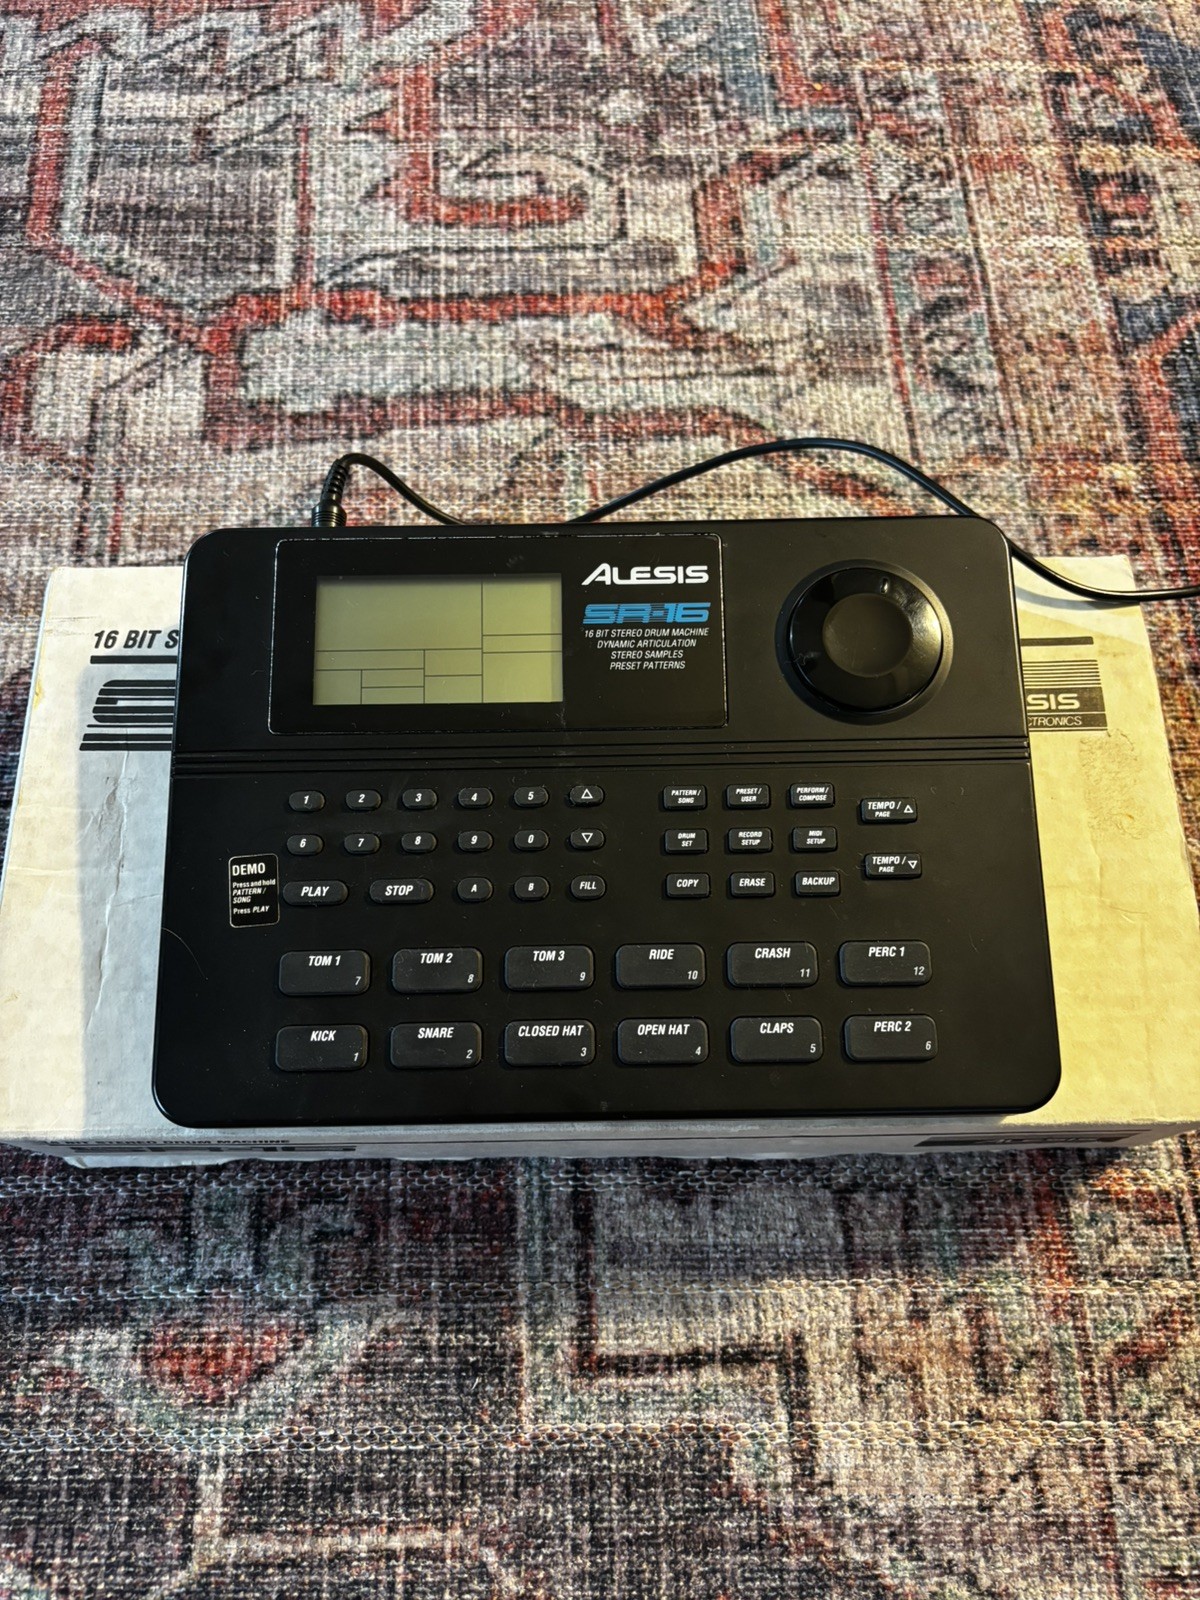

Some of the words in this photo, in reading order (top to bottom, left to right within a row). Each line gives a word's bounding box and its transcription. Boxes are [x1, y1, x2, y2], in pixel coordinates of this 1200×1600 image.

[580, 562, 710, 586] ALESIS
[582, 602, 712, 625] SR-16
[585, 630, 594, 638] 16
[596, 629, 609, 638] BIT
[610, 628, 642, 638] STEREO
[644, 628, 670, 636] DRUM
[672, 628, 709, 636] MACHINE
[94, 630, 119, 649] 16
[123, 630, 162, 649] BIT
[597, 640, 635, 648] DYNAMIC
[636, 639, 697, 648] ARTICULATION
[610, 651, 642, 659] STEREO
[644, 650, 684, 658] SAMPLES
[610, 662, 642, 670] PRESET
[643, 661, 686, 670] PATTERNS
[304, 796, 309, 804] 1
[358, 794, 366, 803] 2
[415, 793, 422, 802] 3
[471, 793, 478, 802] 4
[528, 792, 534, 800] 5
[868, 801, 896, 810] TEMPO
[300, 838, 306, 848] 6
[358, 838, 364, 847] 7
[414, 836, 422, 845] 8
[470, 836, 478, 844] 9
[872, 856, 900, 864] TEMPO
[232, 862, 266, 876] DEMO
[262, 878, 276, 886] hold
[528, 882, 534, 891] B
[579, 881, 597, 890] FILL
[676, 879, 699, 888] COPY
[738, 878, 766, 887] ERASE
[802, 877, 836, 886] BACKUP
[300, 886, 330, 897] PLAY
[384, 884, 414, 896] STOP
[470, 884, 477, 892] A
[232, 896, 252, 904] SONG
[532, 950, 556, 962] TOM
[558, 950, 566, 962] 3
[648, 948, 675, 961] RIDE
[754, 947, 791, 960] CRASH
[867, 946, 896, 958] PERC
[898, 946, 905, 958] 1
[308, 955, 332, 967] TOM
[334, 954, 341, 966] 1
[420, 952, 444, 964] TOM
[445, 952, 454, 964] 2
[686, 970, 698, 981] 10
[799, 968, 811, 979] 11
[912, 966, 925, 977] 12
[354, 976, 362, 986] 7
[467, 974, 474, 984] 8
[579, 972, 586, 982] 9
[517, 1024, 560, 1038] CLOSED
[561, 1024, 584, 1037] HAT
[636, 1024, 666, 1036] OPEN
[667, 1023, 690, 1036] HAT
[758, 1022, 795, 1034] CLAPS
[872, 1020, 901, 1034] PERC
[902, 1020, 912, 1033] 2
[309, 1029, 336, 1042] KICK
[416, 1026, 454, 1040] SNARE
[694, 1046, 702, 1056] 4
[810, 1042, 816, 1054] 5
[924, 1040, 932, 1052] 6
[465, 1048, 474, 1060] 2
[580, 1046, 588, 1058] 3
[352, 1052, 358, 1063] 1
